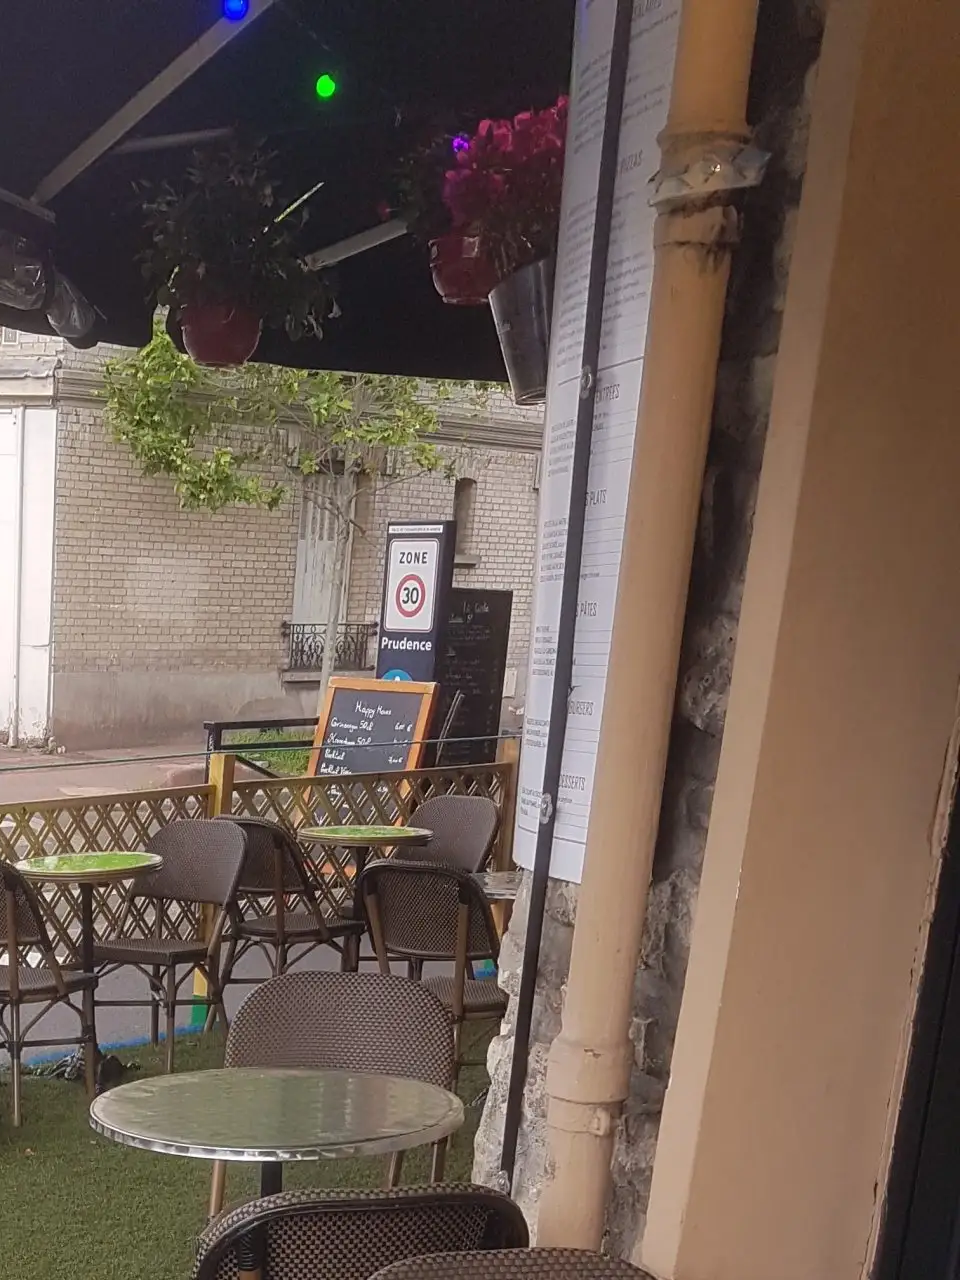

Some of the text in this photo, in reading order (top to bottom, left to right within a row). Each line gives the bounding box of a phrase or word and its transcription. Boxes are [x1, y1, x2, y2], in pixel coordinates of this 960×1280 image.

[399, 551, 428, 564] ZONE
[401, 587, 420, 605] 30
[381, 636, 433, 651] Prudence
[355, 701, 376, 719] Happy
